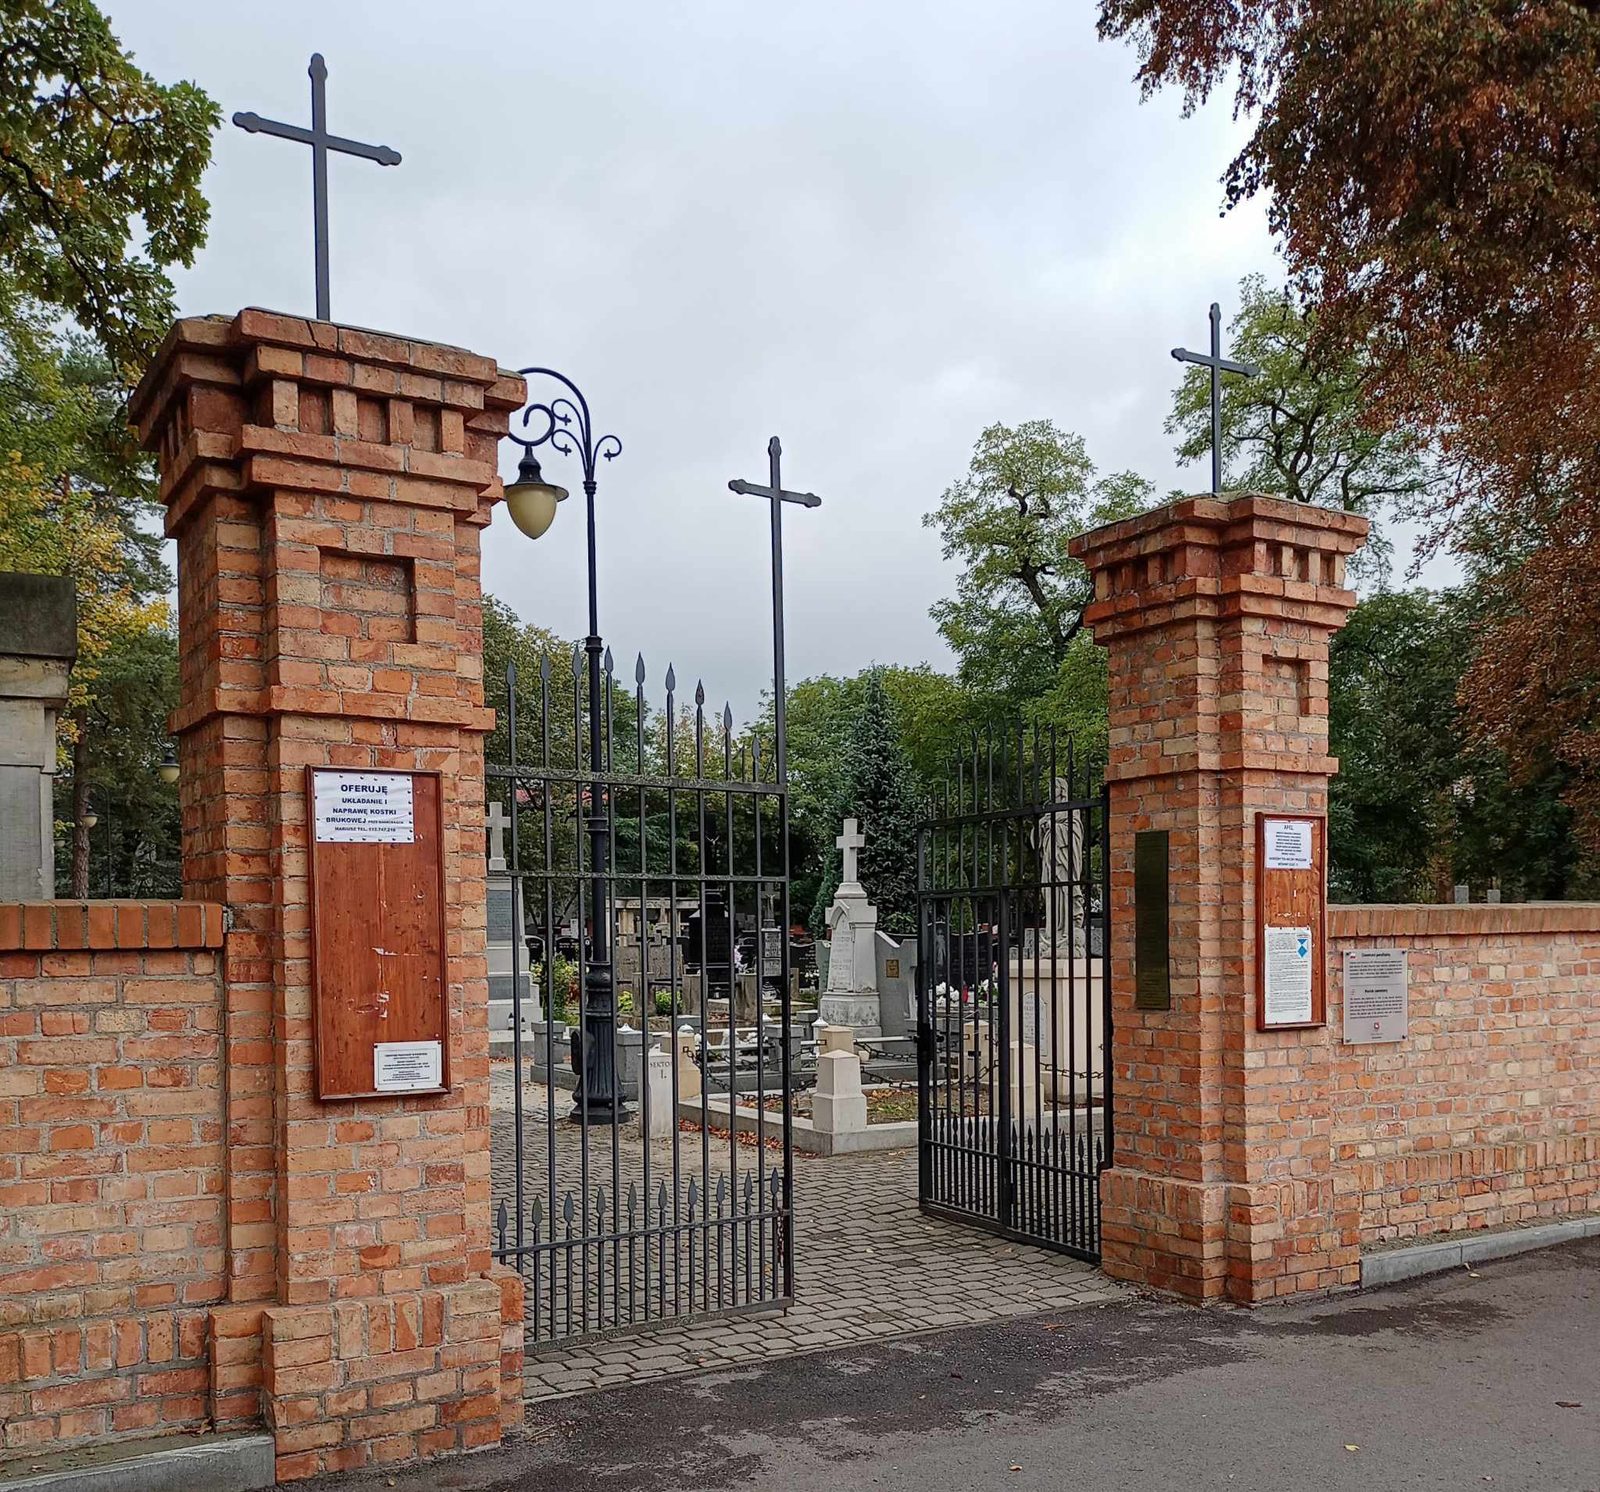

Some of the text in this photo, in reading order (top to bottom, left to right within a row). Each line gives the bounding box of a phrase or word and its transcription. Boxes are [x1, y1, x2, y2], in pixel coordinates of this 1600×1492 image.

[341, 784, 388, 795] OFERUJĘ
[342, 797, 383, 805] UKŁADANIE
[332, 808, 368, 816] NAPRAWĘ
